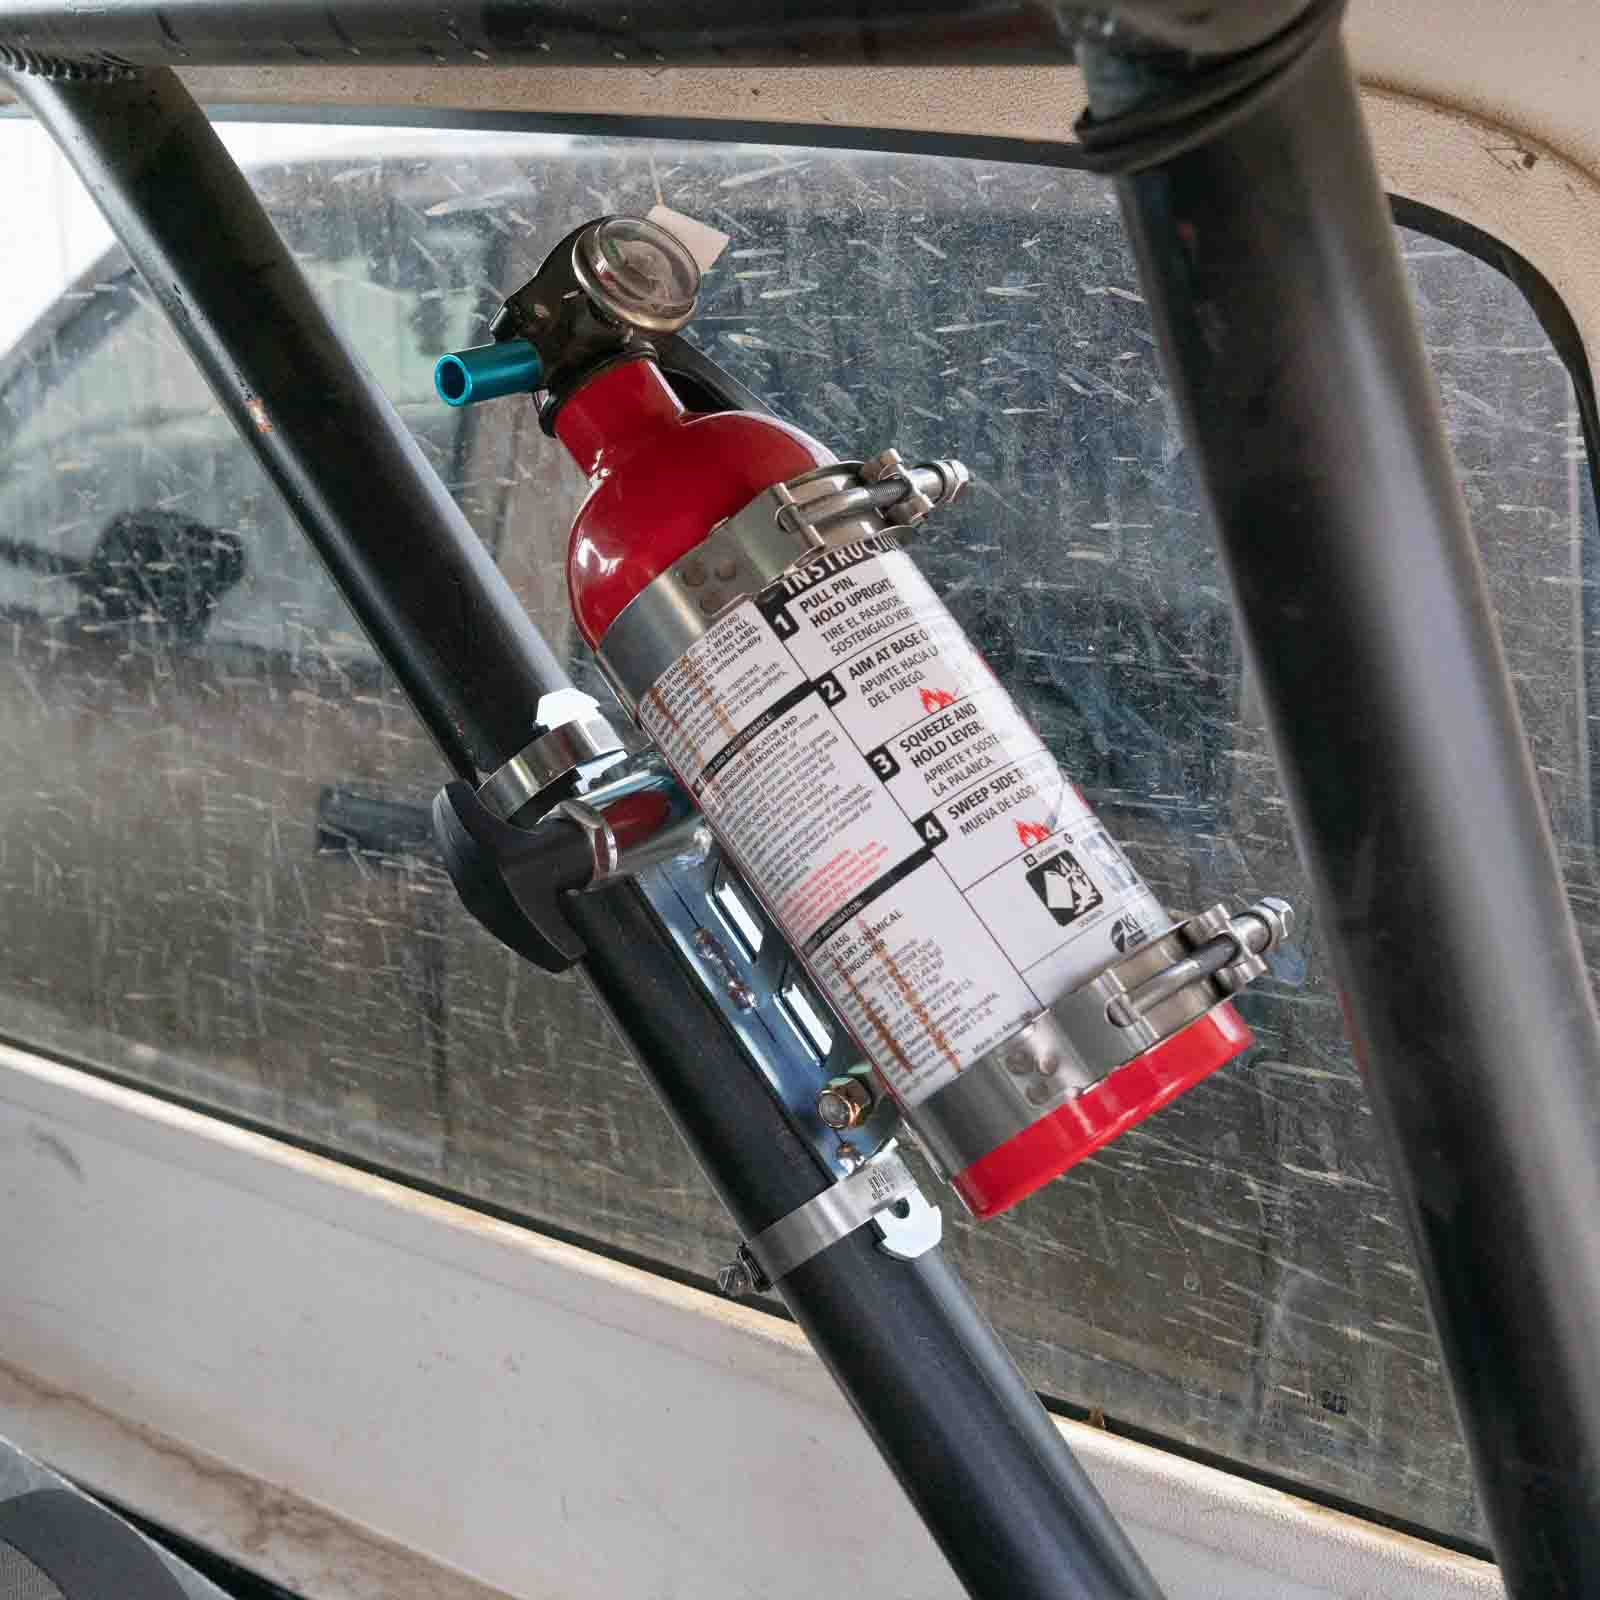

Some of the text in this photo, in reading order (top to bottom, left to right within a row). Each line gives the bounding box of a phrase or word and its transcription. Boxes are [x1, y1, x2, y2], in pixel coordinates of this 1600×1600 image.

[798, 575, 856, 614] PULL PIN.
[772, 612, 791, 633] 1
[809, 599, 848, 629] HOLD
[821, 622, 847, 644] TIRE
[845, 614, 860, 629] EL
[733, 623, 759, 645] LABEL
[831, 615, 895, 656] SOSTENGALO
[846, 656, 876, 681] AIM
[873, 646, 892, 664] AT
[891, 633, 921, 656] BASE
[859, 664, 902, 694] APUNTE
[901, 650, 930, 671] HACIA
[820, 677, 841, 700] 2
[867, 688, 891, 708] DEL
[898, 700, 978, 754] SQUEEZE AND
[910, 717, 985, 768] HOLD LEVER.
[872, 751, 894, 775] 3
[922, 752, 966, 784] APRIETE
[964, 747, 973, 758] Y
[931, 780, 948, 797] LA
[947, 786, 992, 820] SWEEP
[989, 769, 1019, 794] SIDE
[920, 819, 942, 842] 4
[959, 806, 1000, 836] MUEVA
[997, 796, 1015, 813] DE
